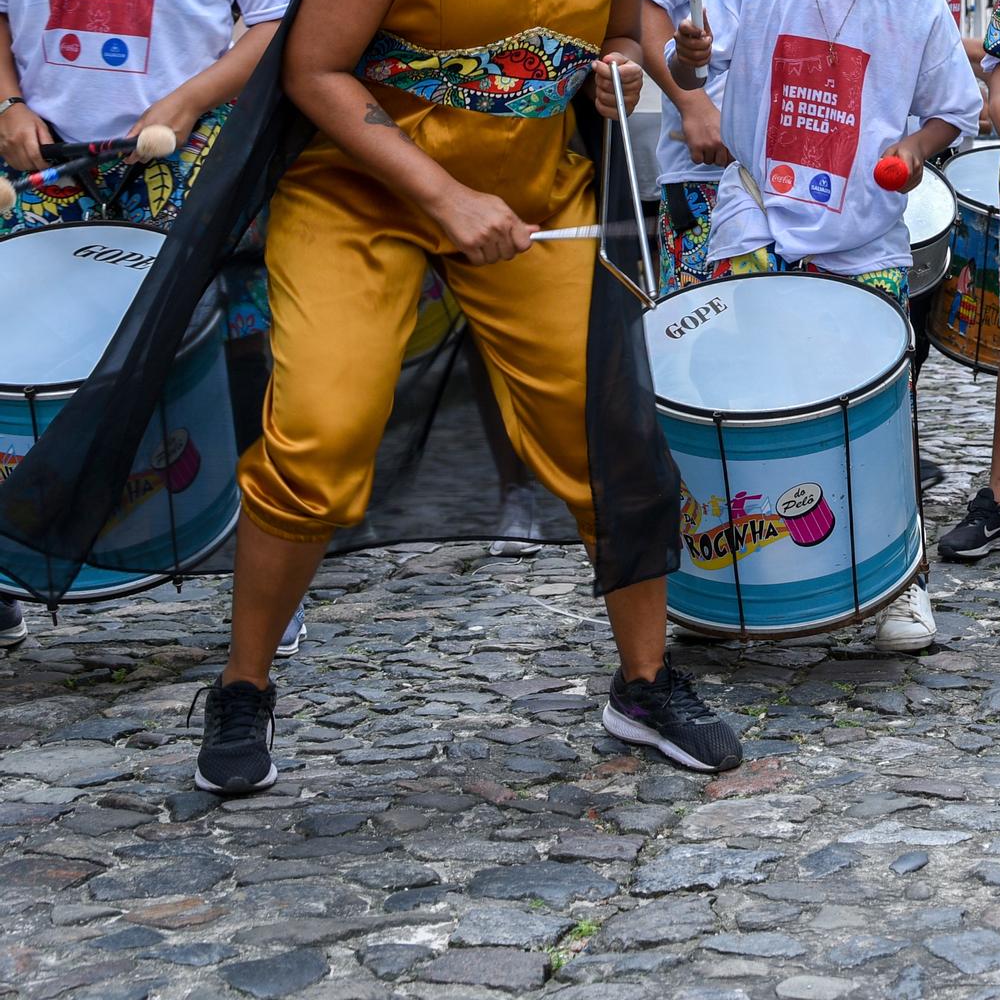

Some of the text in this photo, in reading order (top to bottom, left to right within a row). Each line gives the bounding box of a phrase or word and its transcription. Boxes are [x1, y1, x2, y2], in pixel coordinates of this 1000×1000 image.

[798, 101, 855, 126] ROCINHA
[797, 116, 830, 134] PELÔ
[665, 297, 728, 339] GOPE
[794, 488, 806, 498] do
[782, 494, 815, 513] Pelô
[684, 513, 697, 526] DA
